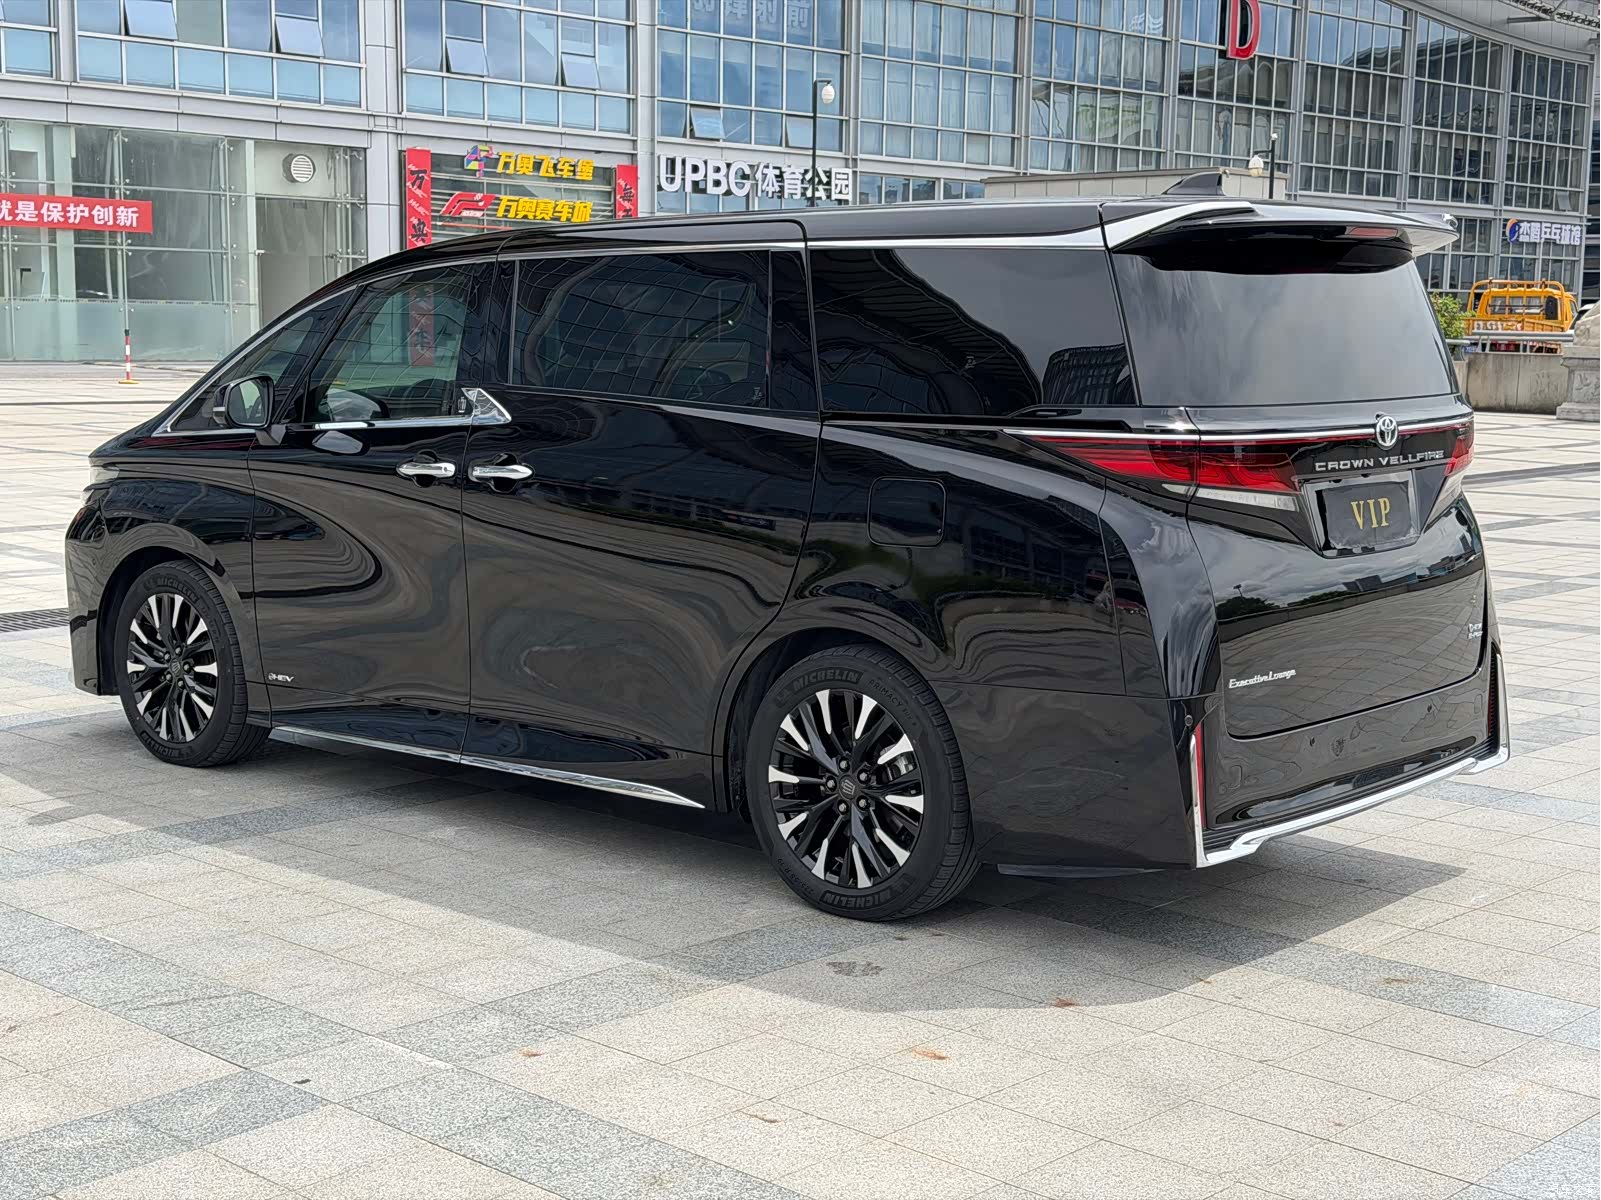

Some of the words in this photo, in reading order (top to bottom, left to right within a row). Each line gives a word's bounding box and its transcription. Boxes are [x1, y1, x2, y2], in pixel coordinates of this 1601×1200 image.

[1228, 0, 1261, 60] D
[497, 151, 594, 180] 万奥飞车堡
[659, 154, 751, 197] UPBC
[755, 161, 852, 201] 体育公园
[1315, 458, 1374, 471] CROWN
[1379, 450, 1445, 466] VELLFIRE
[1350, 497, 1391, 530] VIP
[792, 669, 860, 692] MICHELIN
[868, 678, 903, 707] PRIMACY
